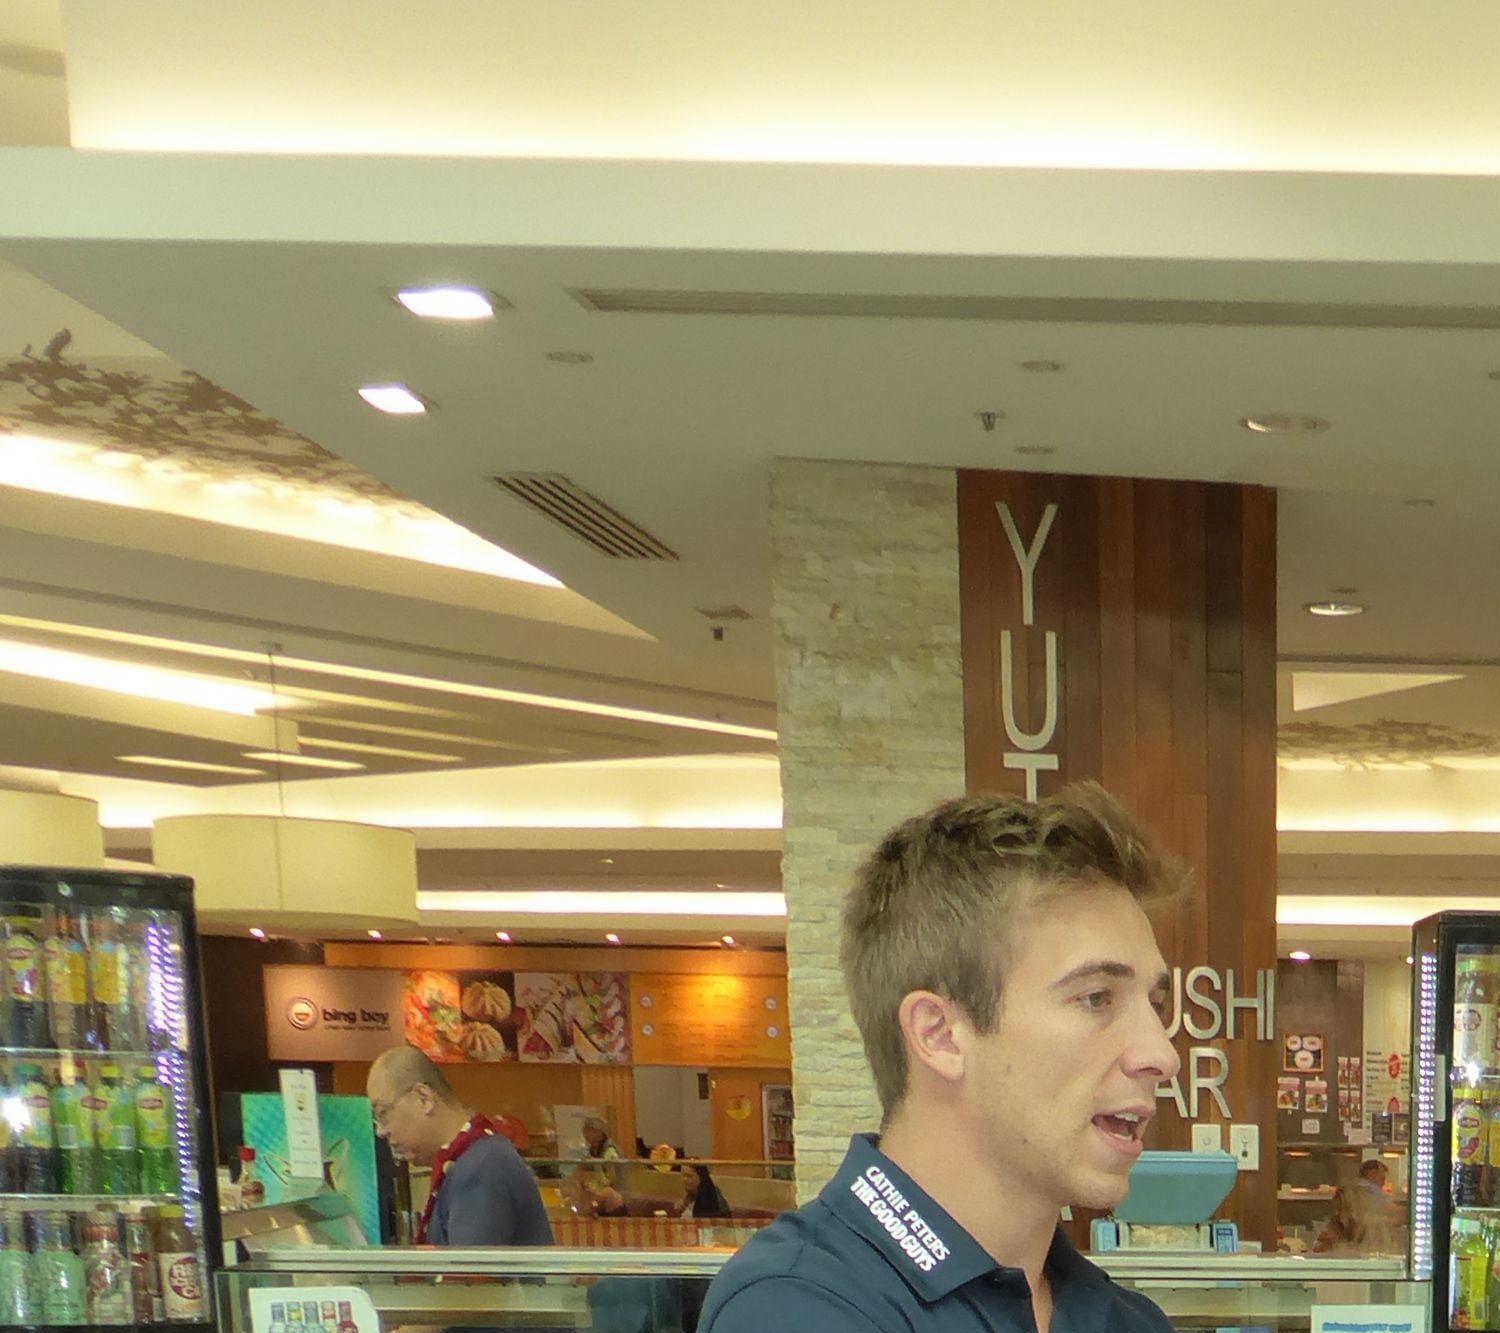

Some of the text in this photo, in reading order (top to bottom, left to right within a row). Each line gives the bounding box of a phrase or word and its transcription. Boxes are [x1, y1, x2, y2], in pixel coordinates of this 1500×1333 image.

[850, 1176, 937, 1271] THE GOOD GUYS
[866, 1166, 950, 1260] CATHIE PETERS
